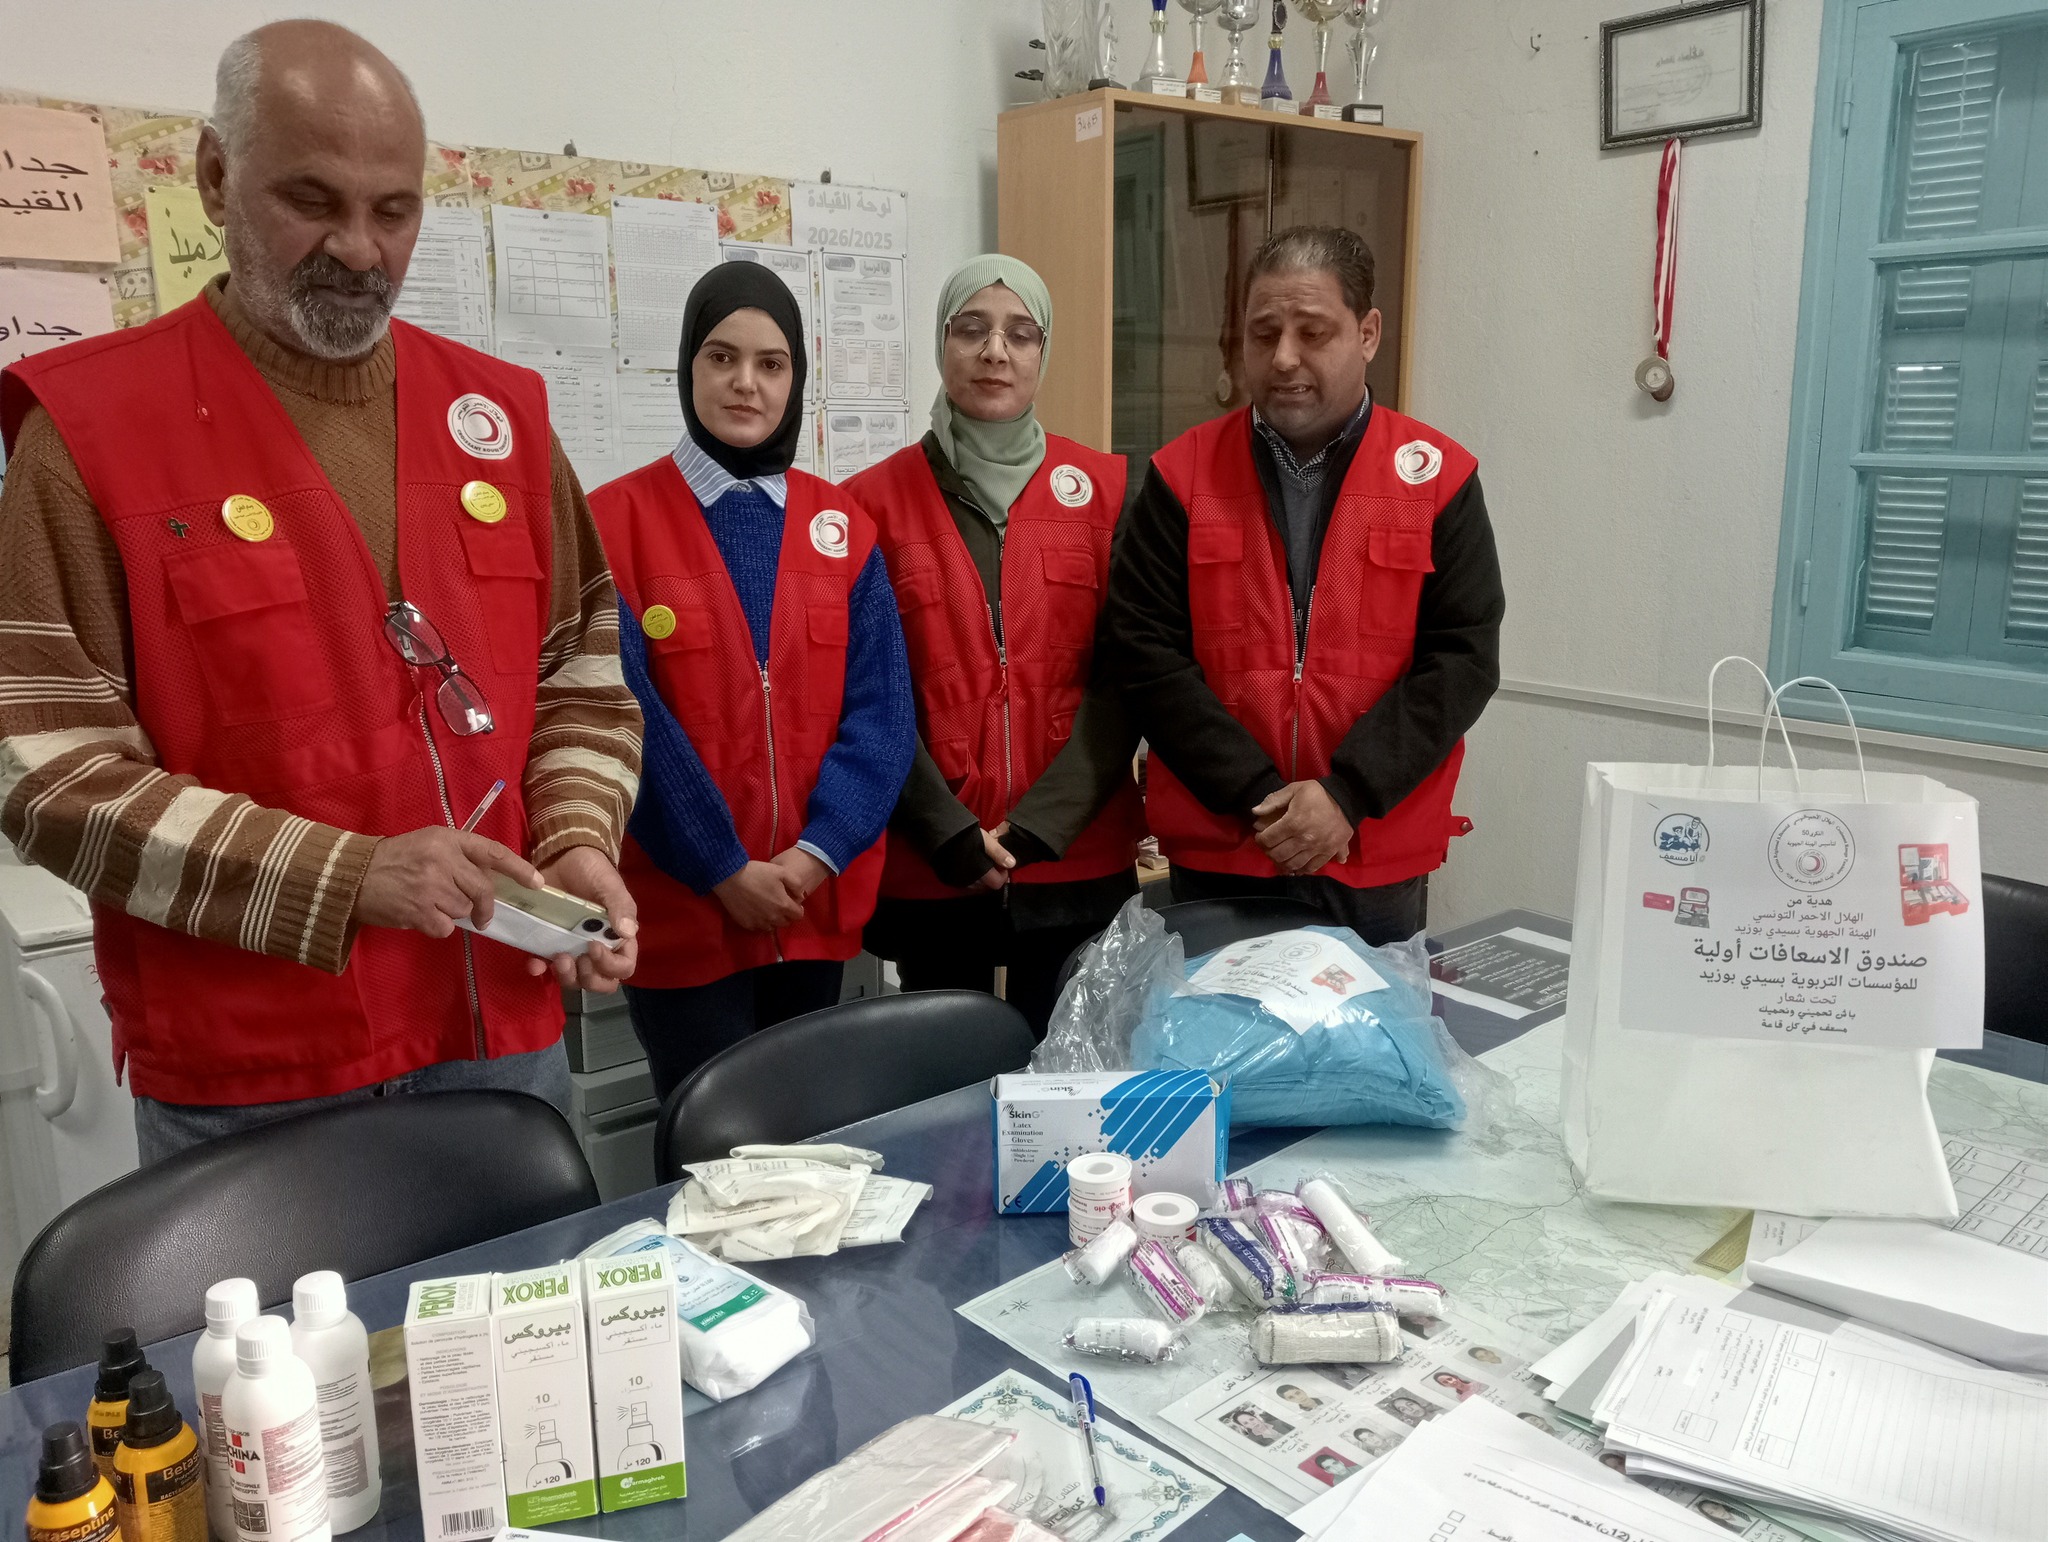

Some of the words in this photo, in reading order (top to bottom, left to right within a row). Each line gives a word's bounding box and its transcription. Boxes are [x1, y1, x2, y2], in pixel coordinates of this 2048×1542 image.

[1, 149, 89, 179] جدا
[0, 189, 83, 215] القيم
[807, 189, 851, 214] القيادة
[856, 191, 892, 218] لوحة
[807, 226, 893, 250] 2026/2025
[0, 315, 83, 342] جداو
[1786, 897, 1803, 908] من
[1806, 895, 1833, 908] هدية
[1752, 910, 1796, 923] التونسي
[1798, 911, 1831, 922] الاحمر
[1833, 912, 1864, 925] الهلال
[1734, 923, 1763, 935] بوزيد
[1765, 927, 1801, 940] بسيدي
[1804, 926, 1845, 938] الجهوية
[1848, 927, 1877, 940] الهيئة
[1693, 937, 1742, 963] أولية
[1749, 942, 1850, 965] الاسعافات
[1856, 949, 1928, 972] صندوق
[1699, 968, 1736, 985] بوزيد
[1740, 974, 1786, 990] بسيدي
[1791, 972, 1843, 990] التربوية
[1847, 975, 1919, 993] للمؤسسات
[1776, 992, 1806, 1005] شعار
[1809, 994, 1837, 1005] تحت
[1761, 1018, 1783, 1029] قاعة
[1785, 1021, 1801, 1032] كل
[1801, 1021, 1817, 1035] في
[1008, 1109, 1041, 1119] SkinG
[1012, 1121, 1032, 1129] Latex
[1001, 1129, 1044, 1137] Examination
[1011, 1136, 1034, 1144] Gloves
[597, 1261, 663, 1289] PEROX
[502, 1274, 570, 1306] PEROX
[417, 1281, 458, 1320] PEROX
[600, 1305, 667, 1327] بيروكس
[504, 1322, 572, 1345] بيروكس
[628, 1374, 644, 1387] 10
[535, 1393, 551, 1404] 10
[226, 1445, 261, 1461] CHINA
[635, 1457, 651, 1467] 120
[544, 1475, 561, 1484] 120
